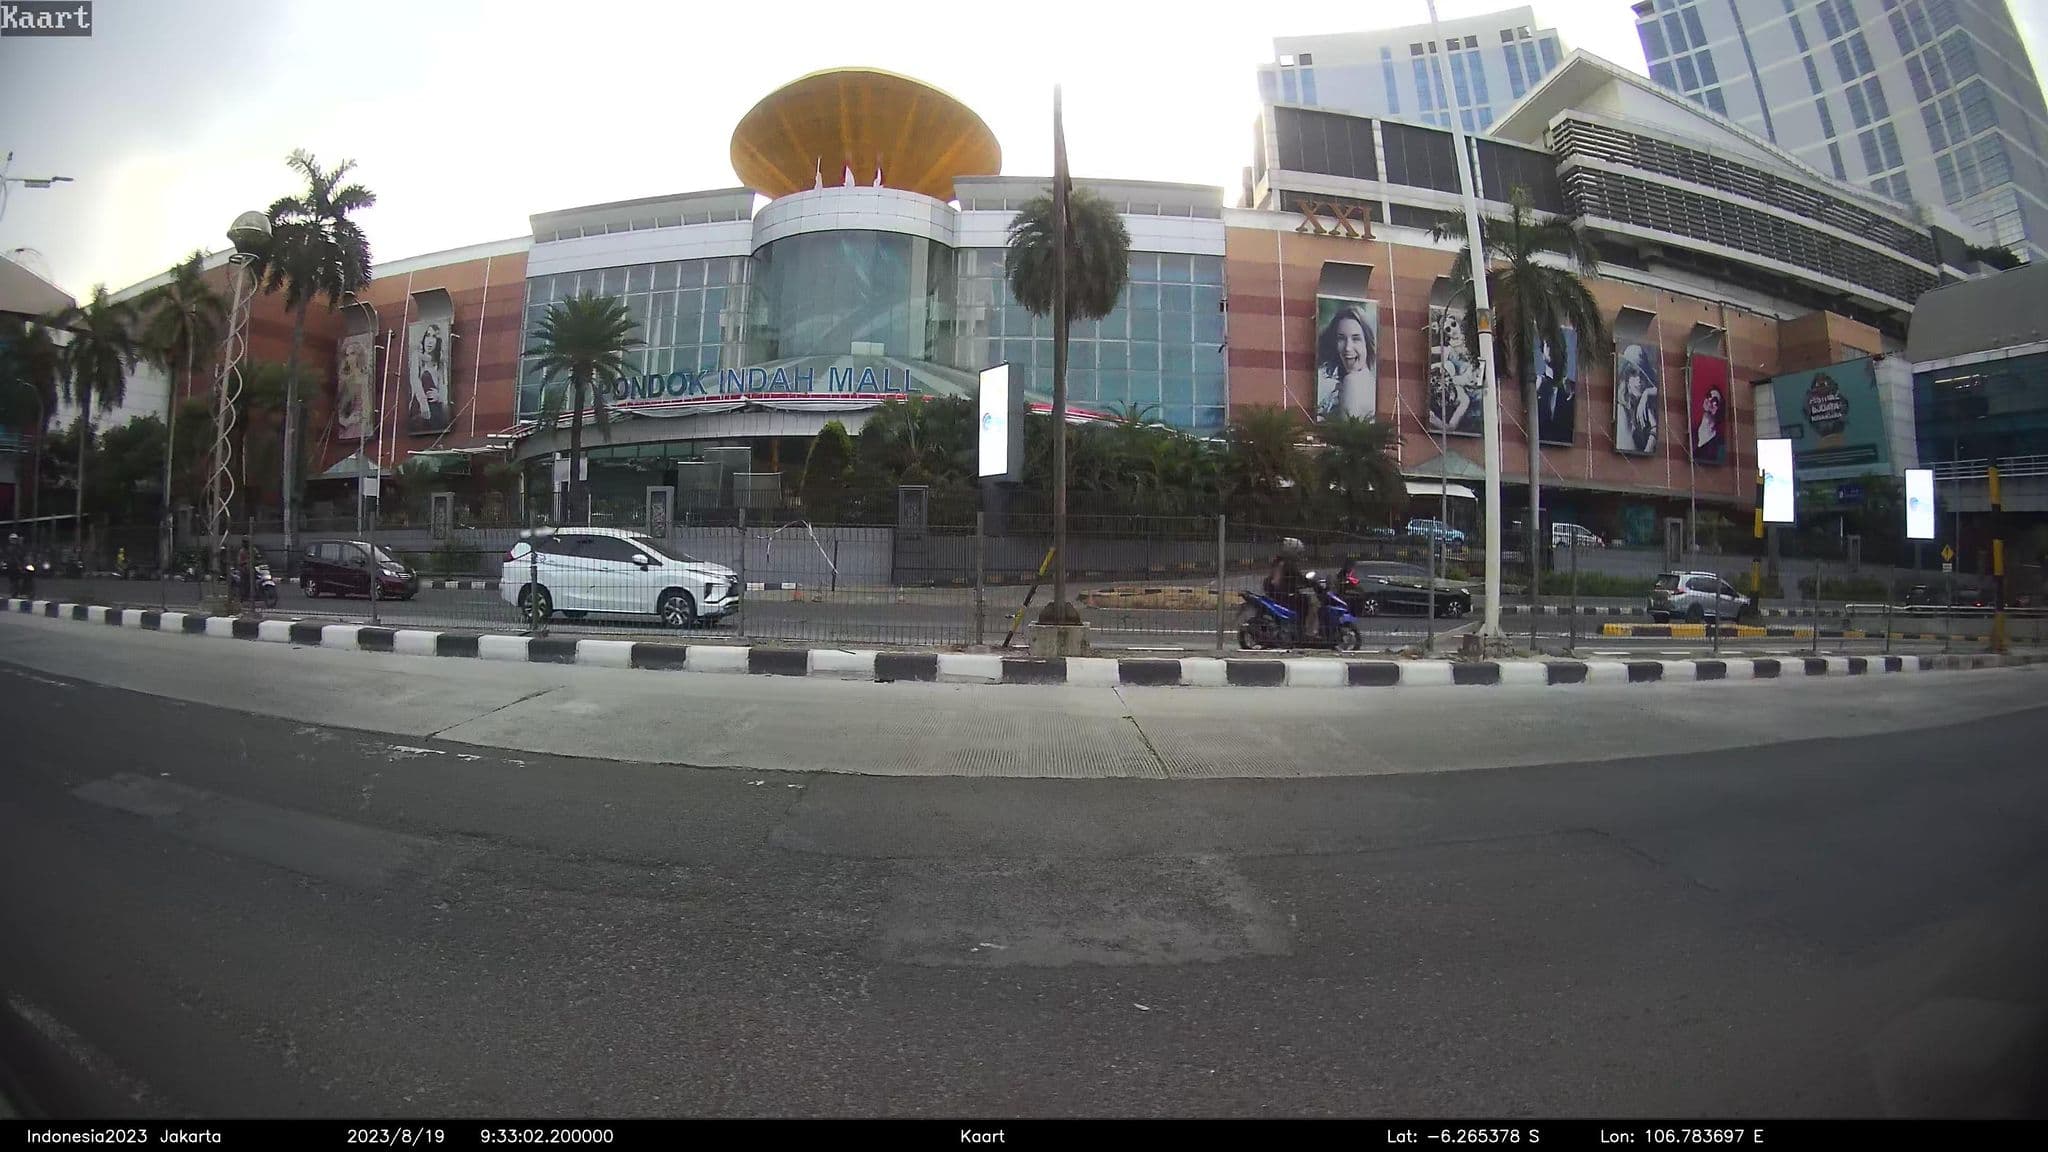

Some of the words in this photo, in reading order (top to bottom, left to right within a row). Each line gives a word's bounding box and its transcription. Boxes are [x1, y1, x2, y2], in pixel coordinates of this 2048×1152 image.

[1295, 198, 1376, 239] XXI
[601, 369, 709, 400] PONDOK
[718, 367, 814, 393] INDAH
[828, 366, 922, 393] MALL
